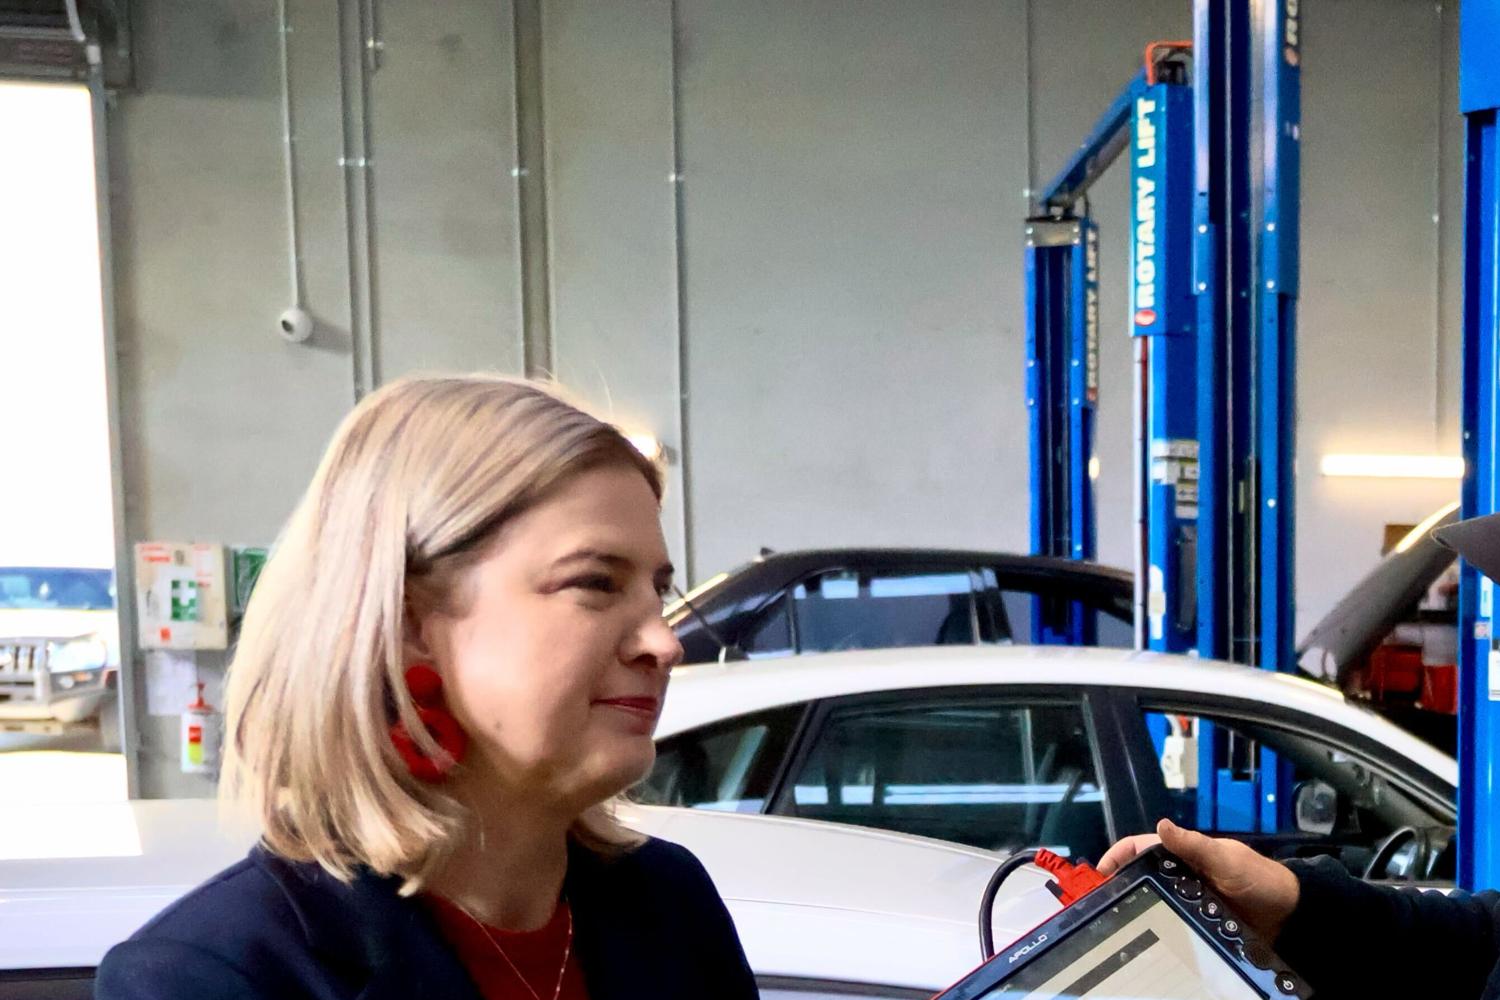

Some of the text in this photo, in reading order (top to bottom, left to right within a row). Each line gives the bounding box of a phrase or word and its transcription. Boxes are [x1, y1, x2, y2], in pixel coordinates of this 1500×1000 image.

[1136, 97, 1156, 309] ROTARY LIFT
[1008, 934, 1048, 964] APOLLO
